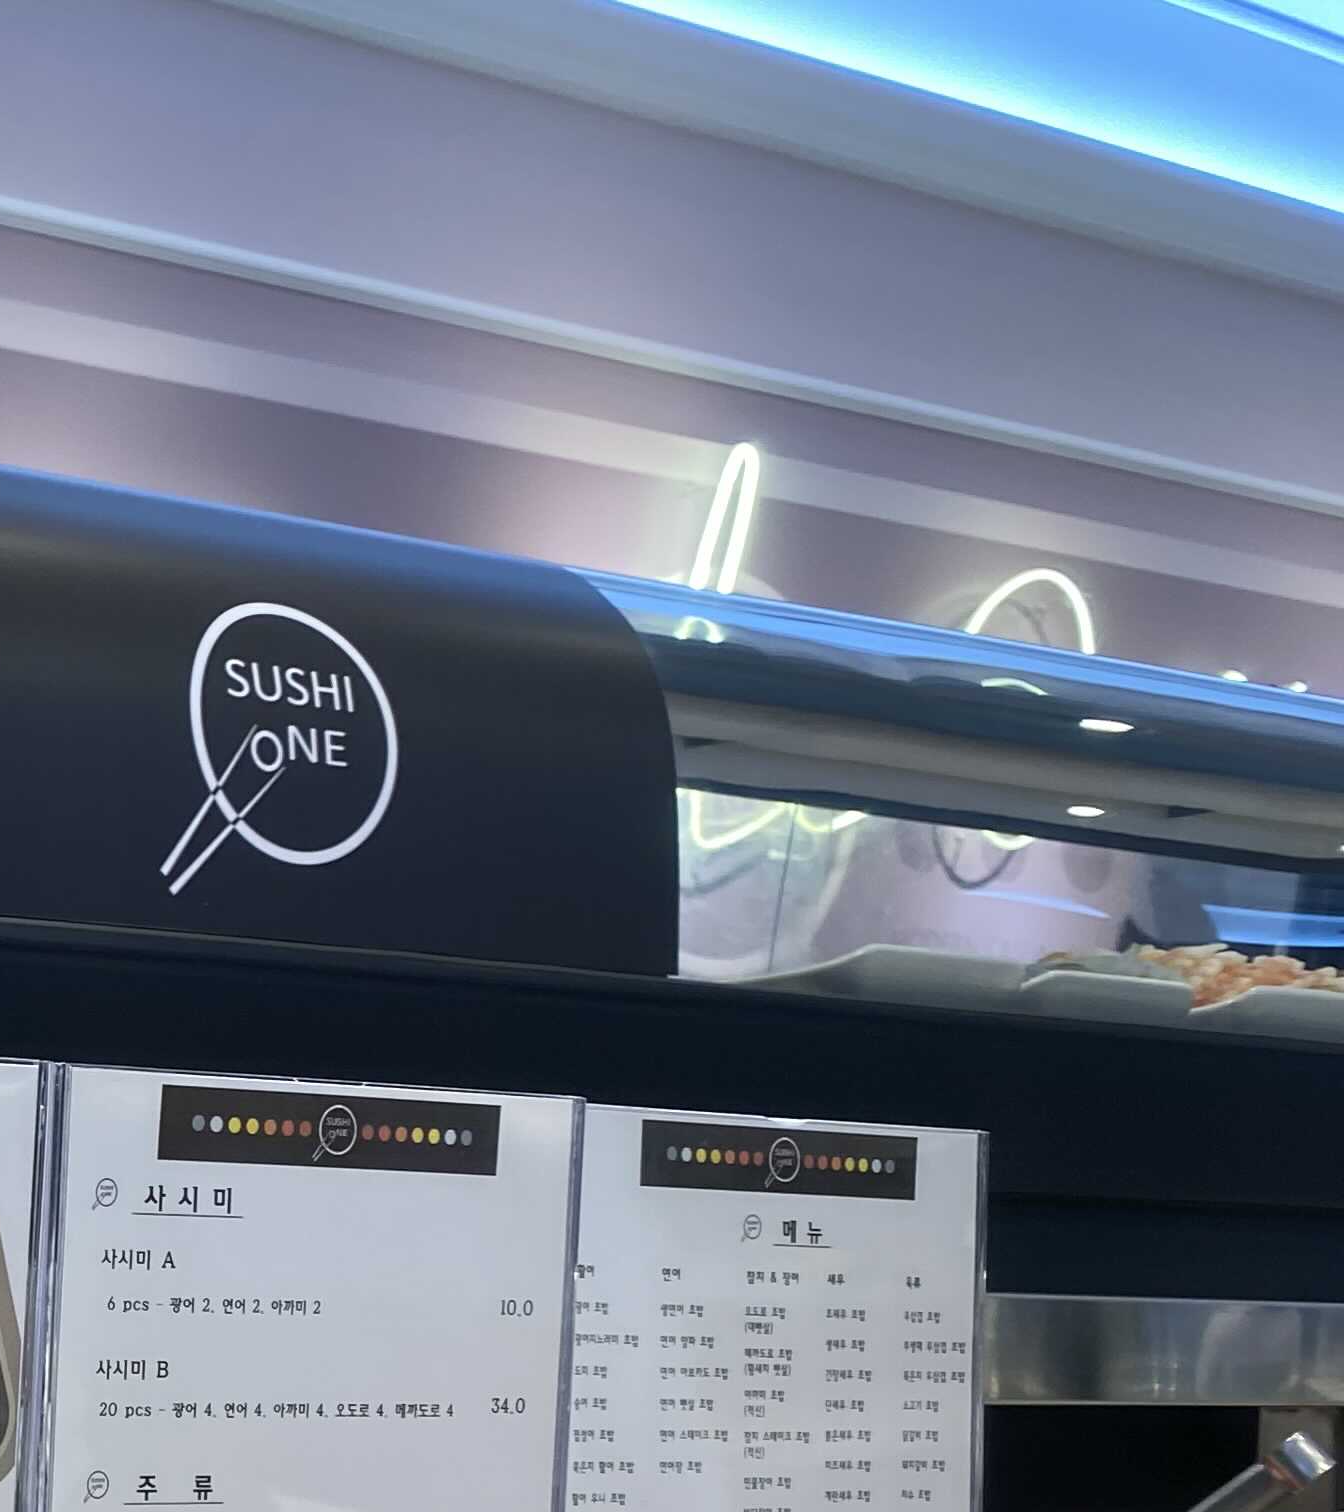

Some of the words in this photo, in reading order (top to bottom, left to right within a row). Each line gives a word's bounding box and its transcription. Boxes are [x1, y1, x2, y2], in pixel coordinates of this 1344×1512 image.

[224, 658, 354, 712] SUSHI
[251, 724, 348, 772] ONE
[101, 1248, 151, 1271] 사시미
[161, 1250, 177, 1269] A
[500, 1299, 534, 1318] 10.0
[95, 1359, 146, 1381] 사시미
[156, 1360, 169, 1379] B
[490, 1397, 526, 1415] 34.0
